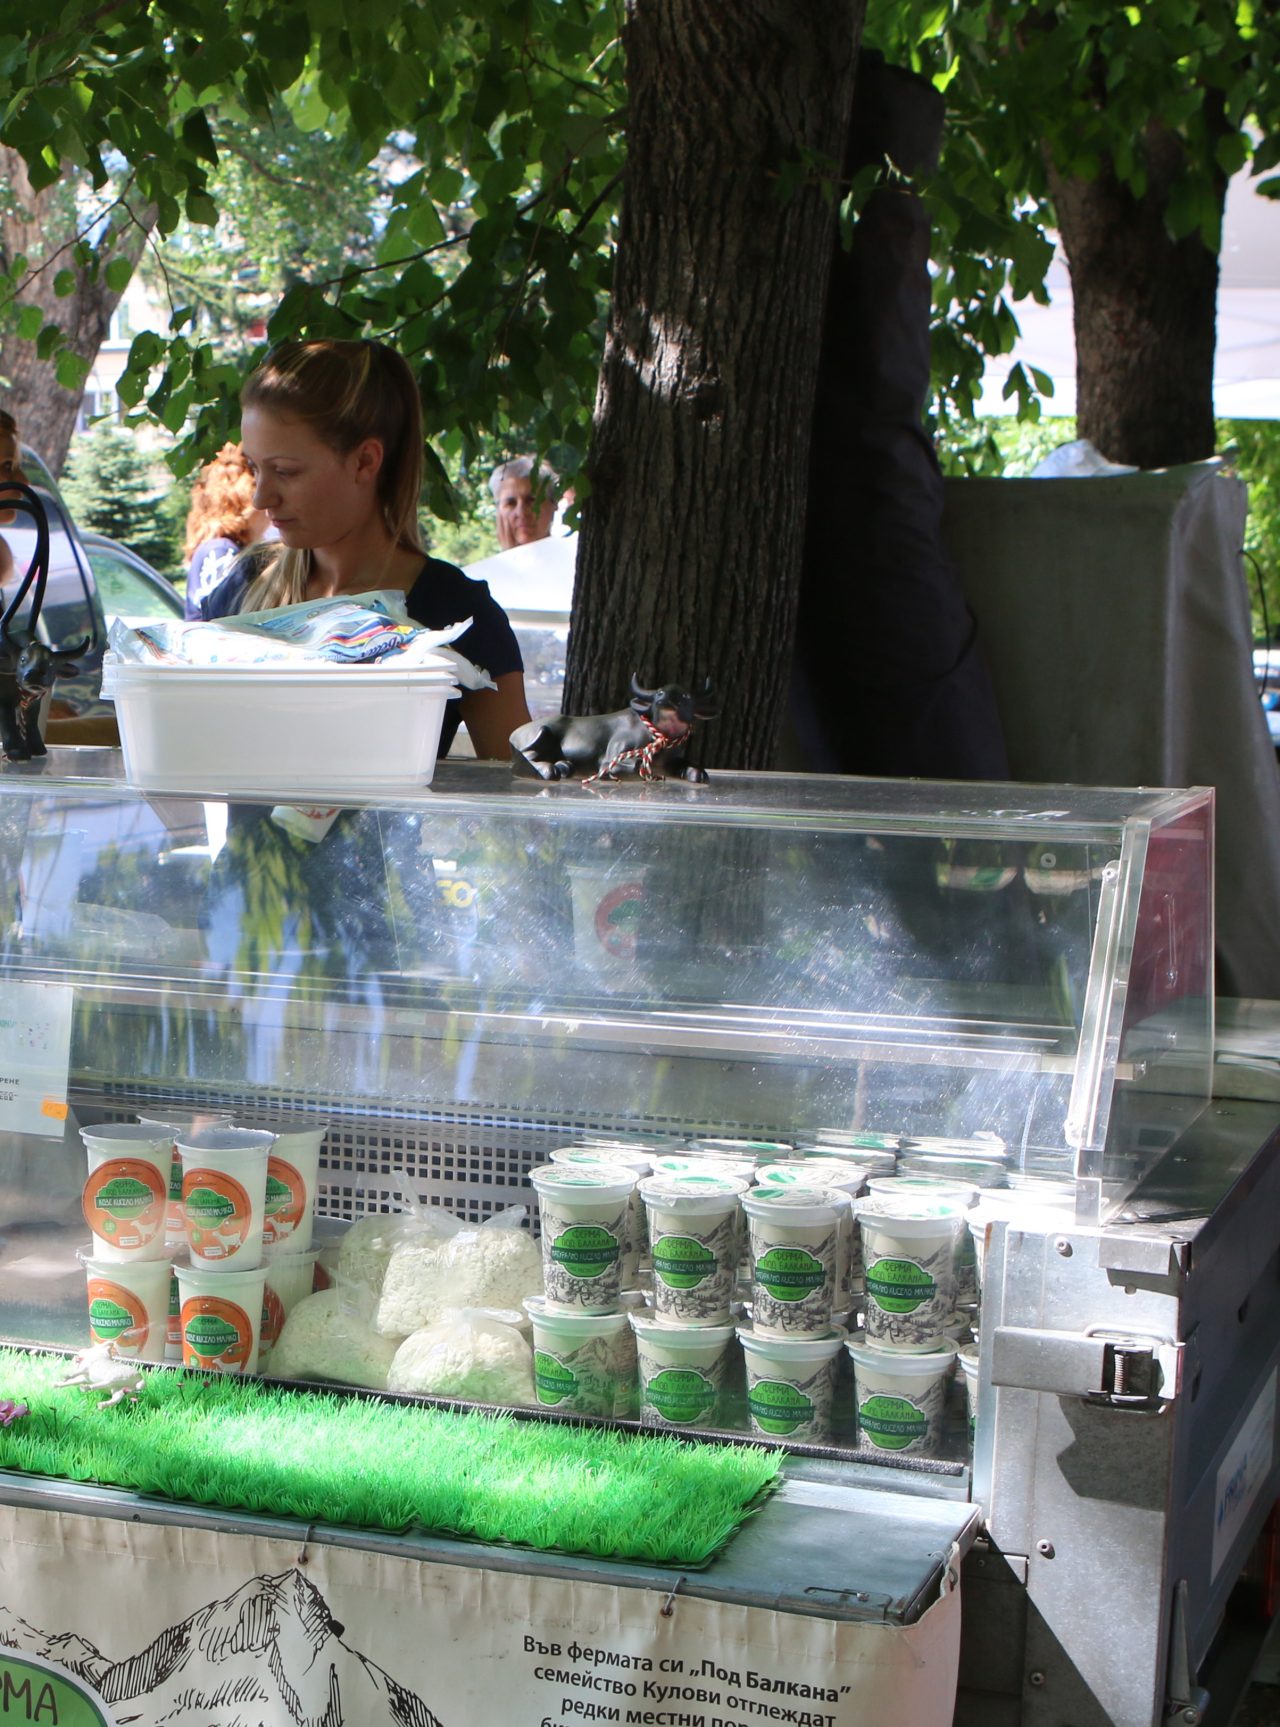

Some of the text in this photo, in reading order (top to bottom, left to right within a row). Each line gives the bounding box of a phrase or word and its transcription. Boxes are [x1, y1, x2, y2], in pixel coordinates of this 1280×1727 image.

[523, 1635, 562, 1656] Във
[567, 1641, 653, 1672] фермата
[659, 1658, 684, 1674] си
[690, 1660, 741, 1688] „Под
[534, 1664, 836, 1727] семейство Кулови отглеждат
[561, 1697, 620, 1721] редки
[626, 1710, 706, 1727] местни
